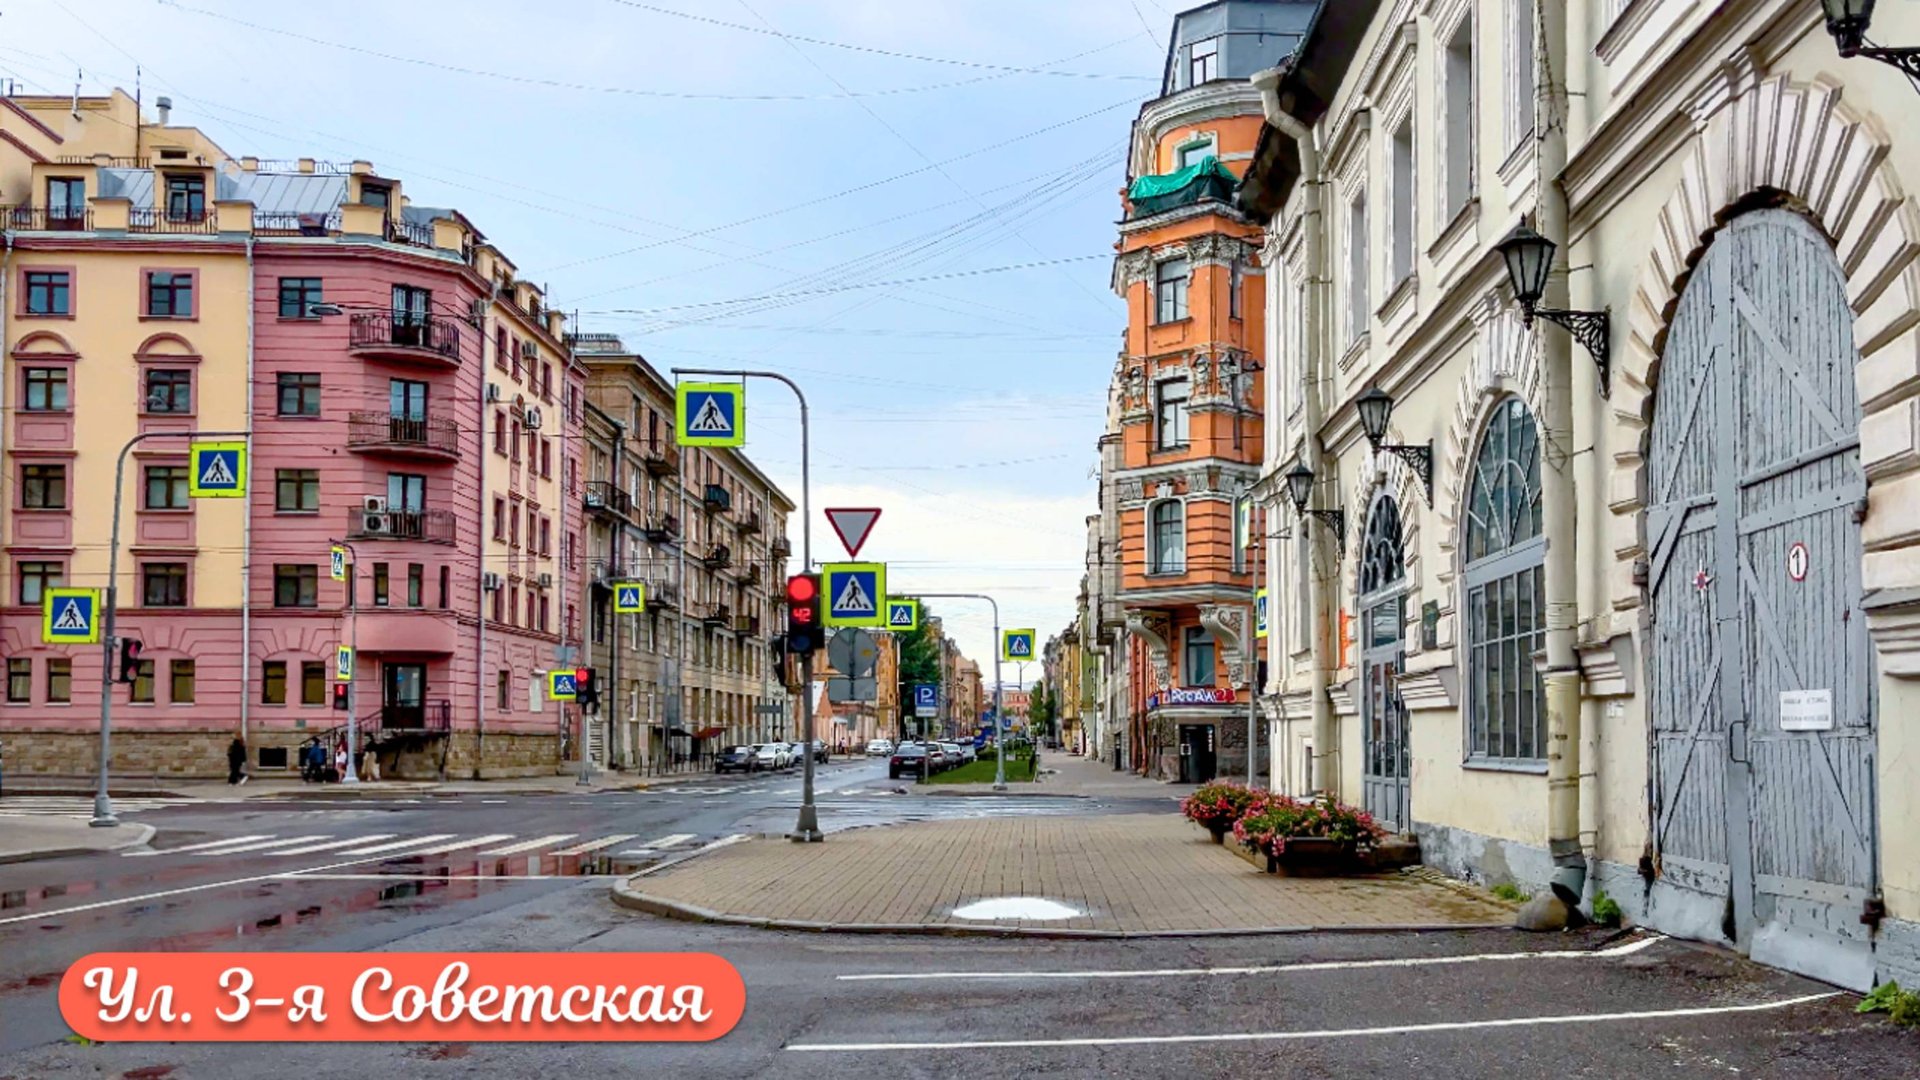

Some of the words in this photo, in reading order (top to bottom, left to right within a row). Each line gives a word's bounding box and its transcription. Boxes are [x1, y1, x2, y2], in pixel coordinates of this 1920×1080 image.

[1791, 547, 1801, 576] 1
[792, 607, 812, 622] 42
[920, 687, 934, 703] P
